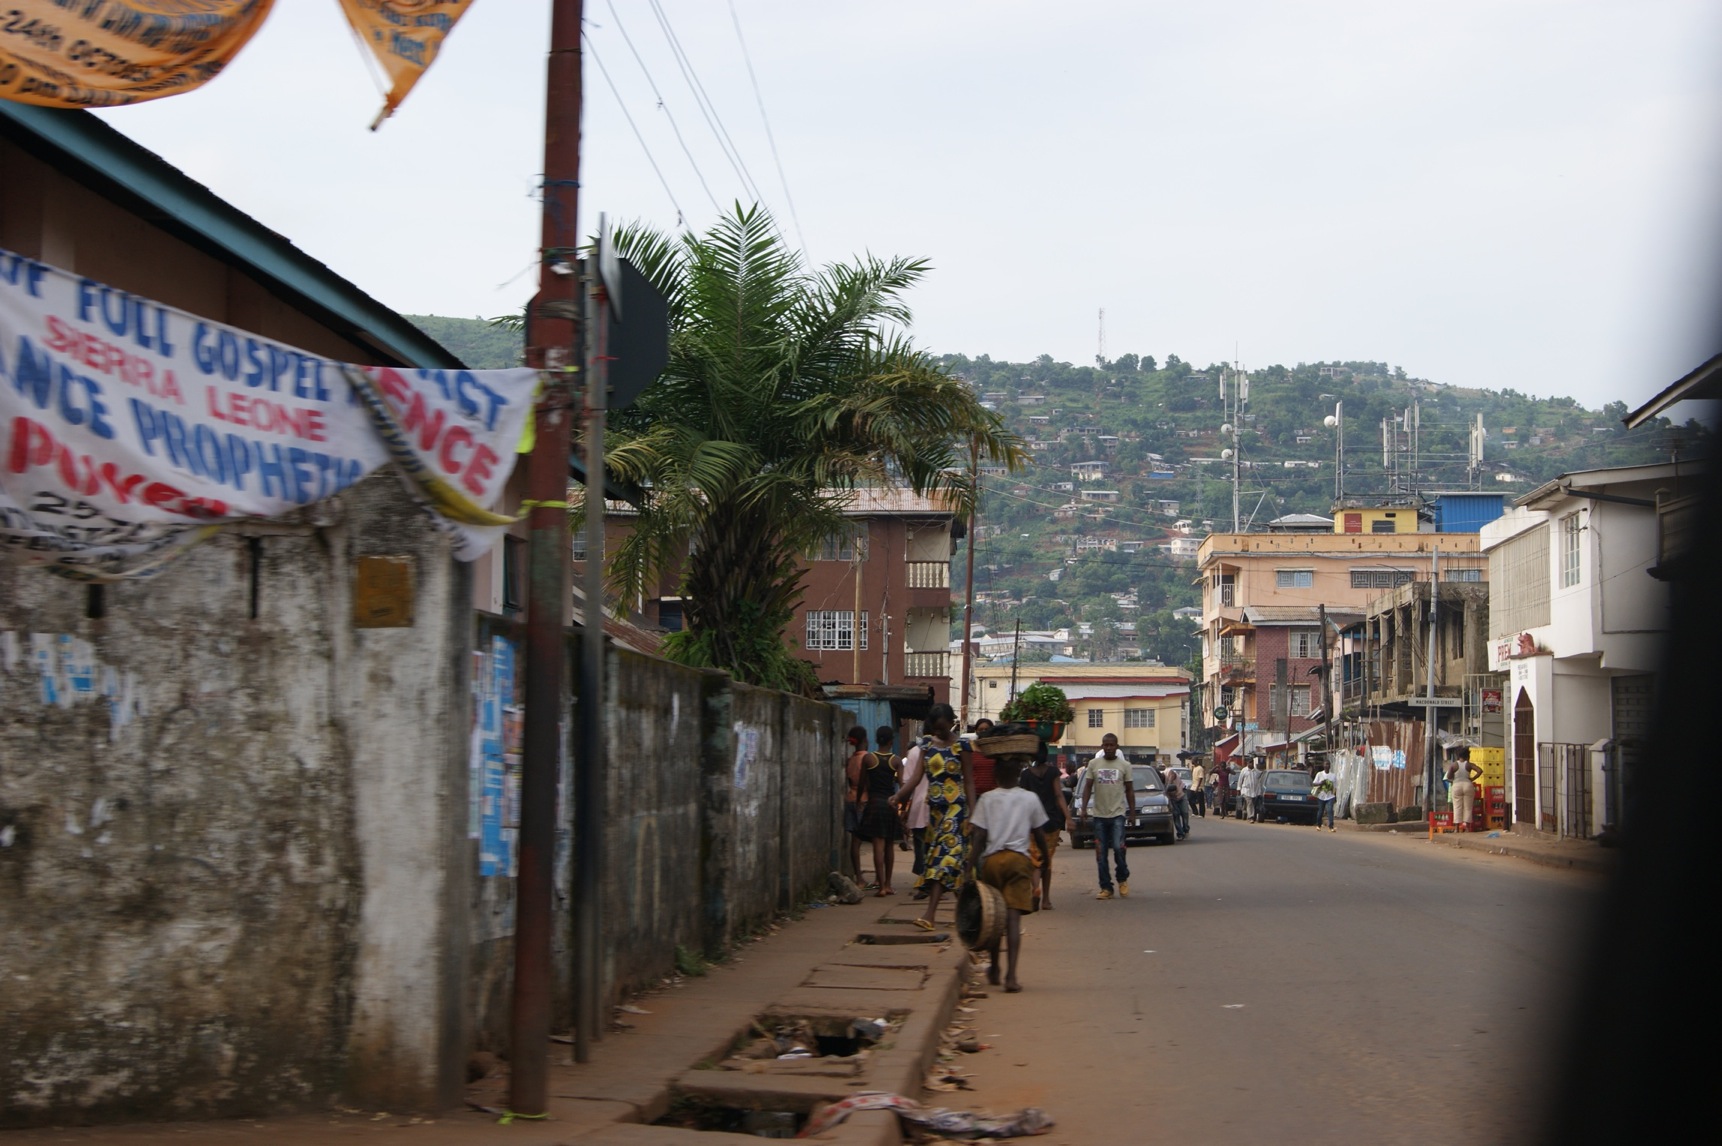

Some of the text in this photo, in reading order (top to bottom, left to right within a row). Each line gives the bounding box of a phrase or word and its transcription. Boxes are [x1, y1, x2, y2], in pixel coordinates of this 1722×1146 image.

[43, 314, 328, 442] SIERRA LEONE
[77, 277, 175, 359] FULL
[192, 321, 331, 402] GOSPEL
